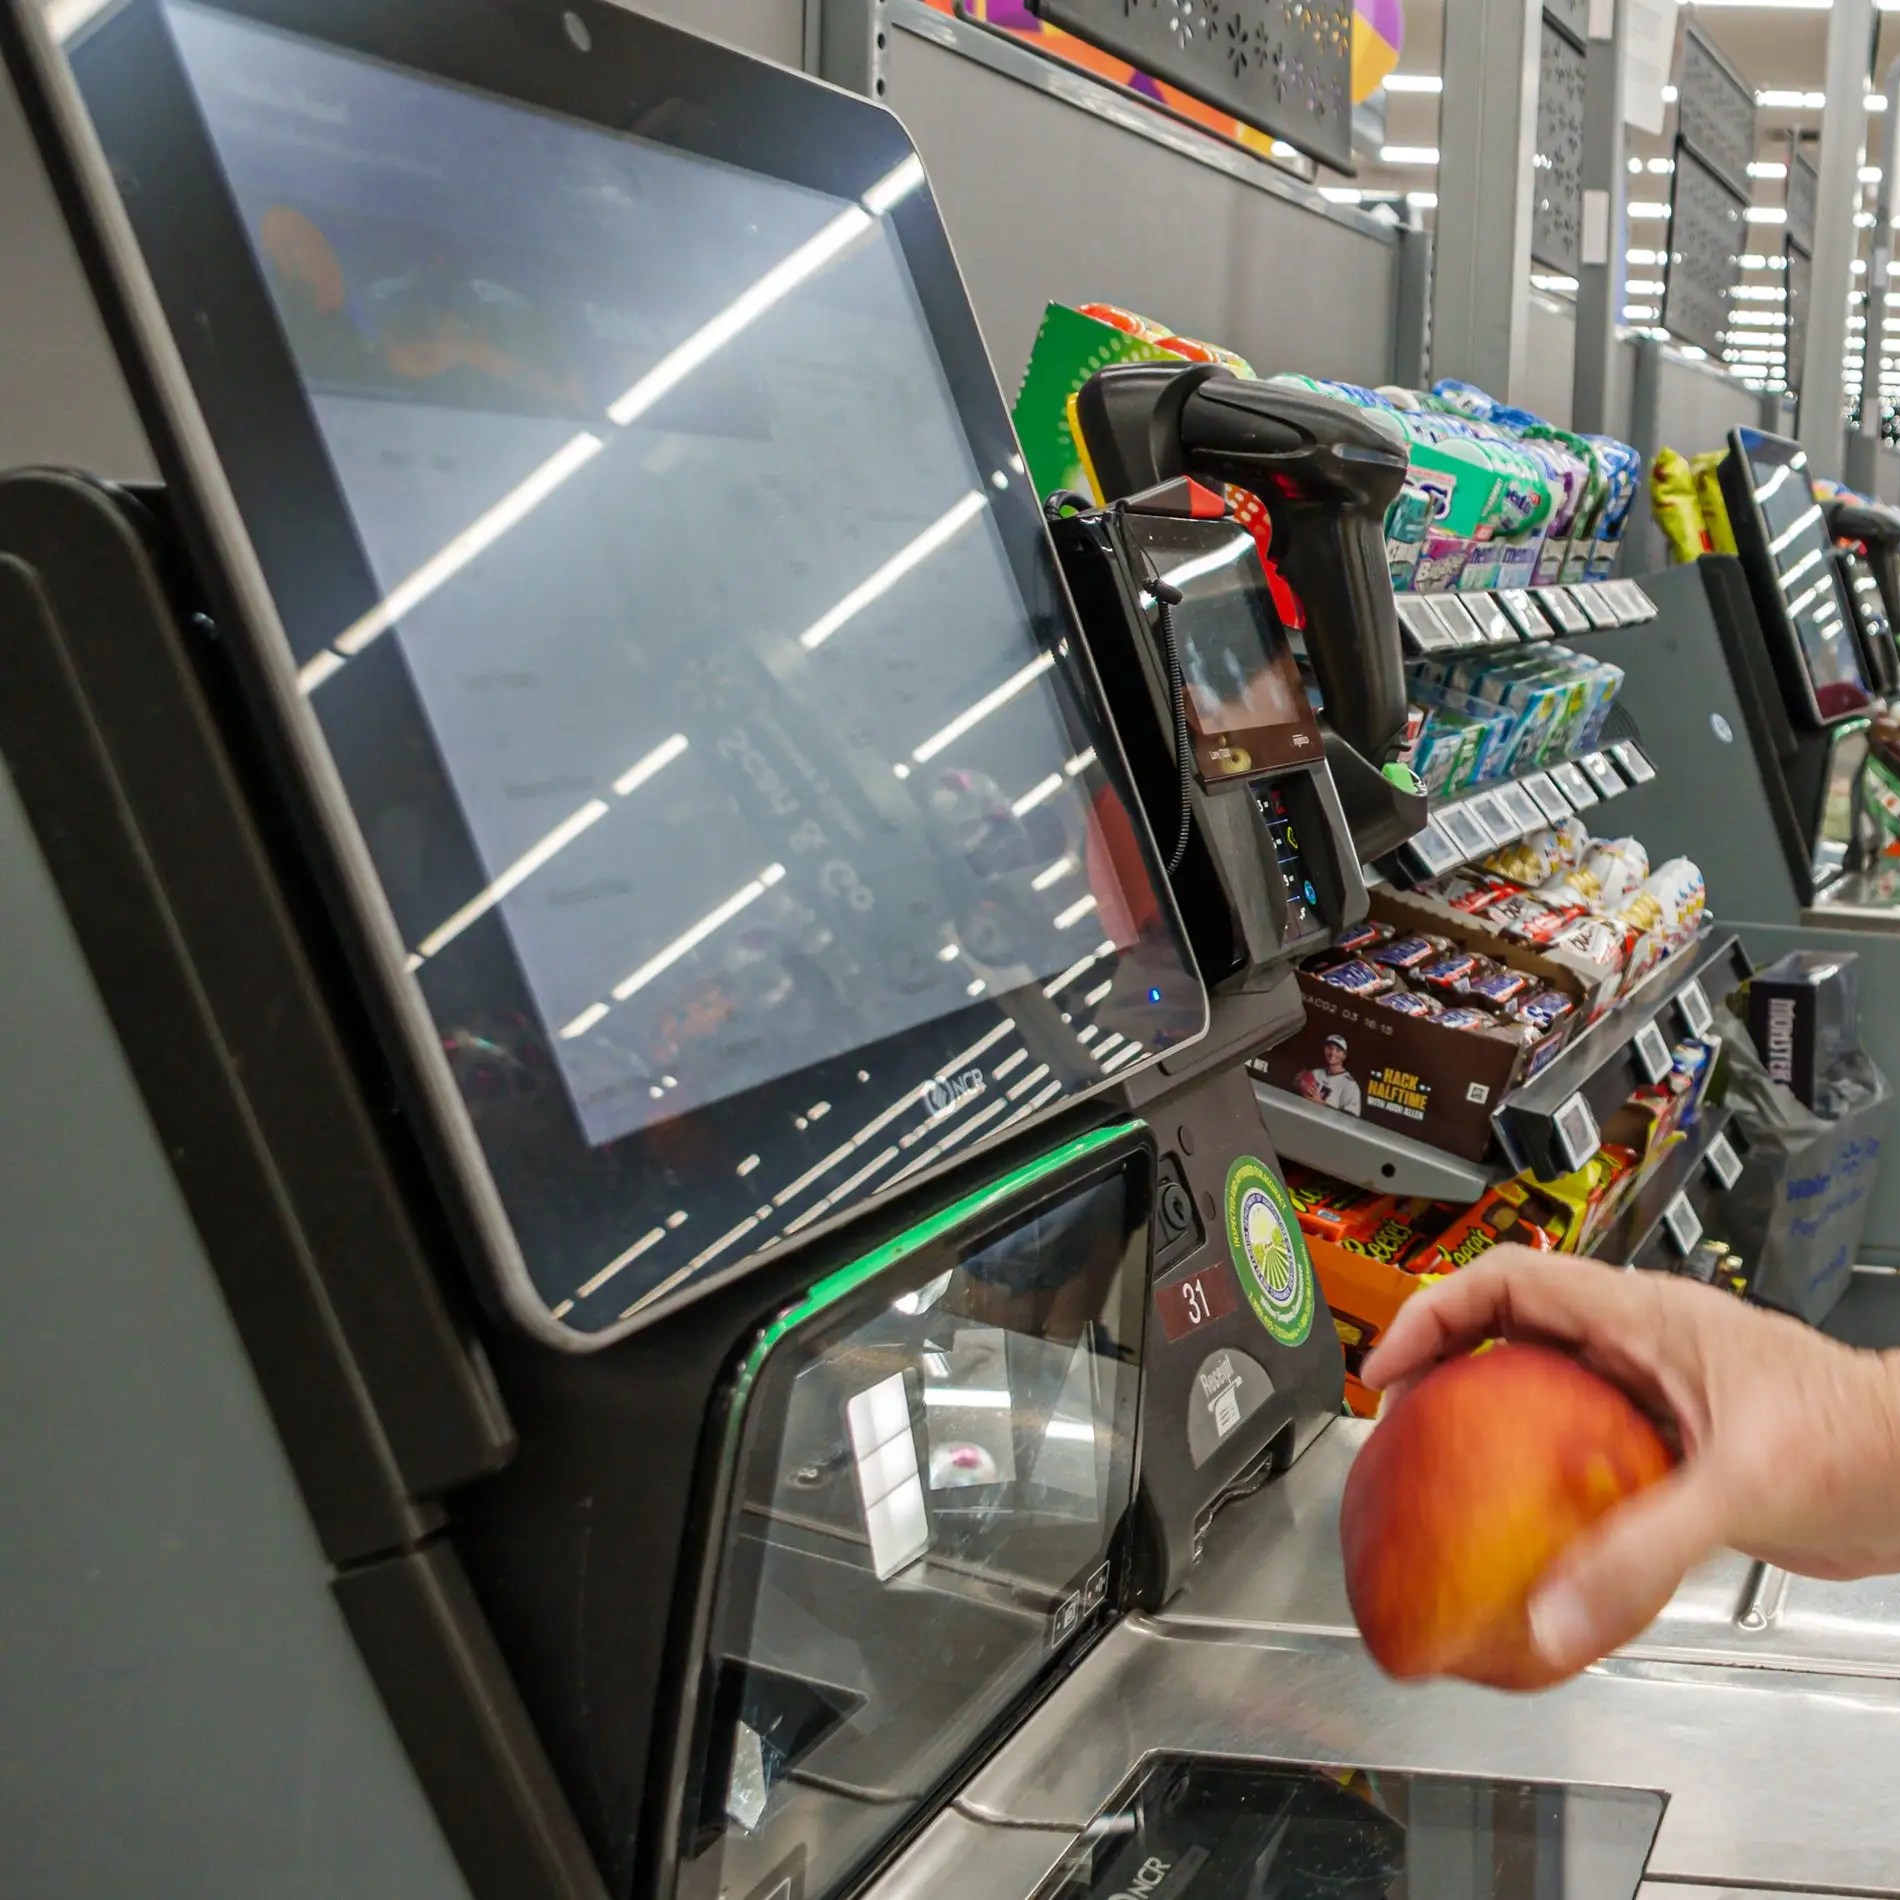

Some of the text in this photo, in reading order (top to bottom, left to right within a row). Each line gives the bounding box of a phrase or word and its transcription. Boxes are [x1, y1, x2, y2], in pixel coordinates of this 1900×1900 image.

[953, 1068, 984, 1097] NCR
[1367, 1080, 1429, 1111] HALFTIME
[1383, 1067, 1419, 1092] HACK
[1182, 1278, 1211, 1326] 31
[1200, 1354, 1235, 1399] Receipt
[1128, 1856, 1172, 1900] NCR
